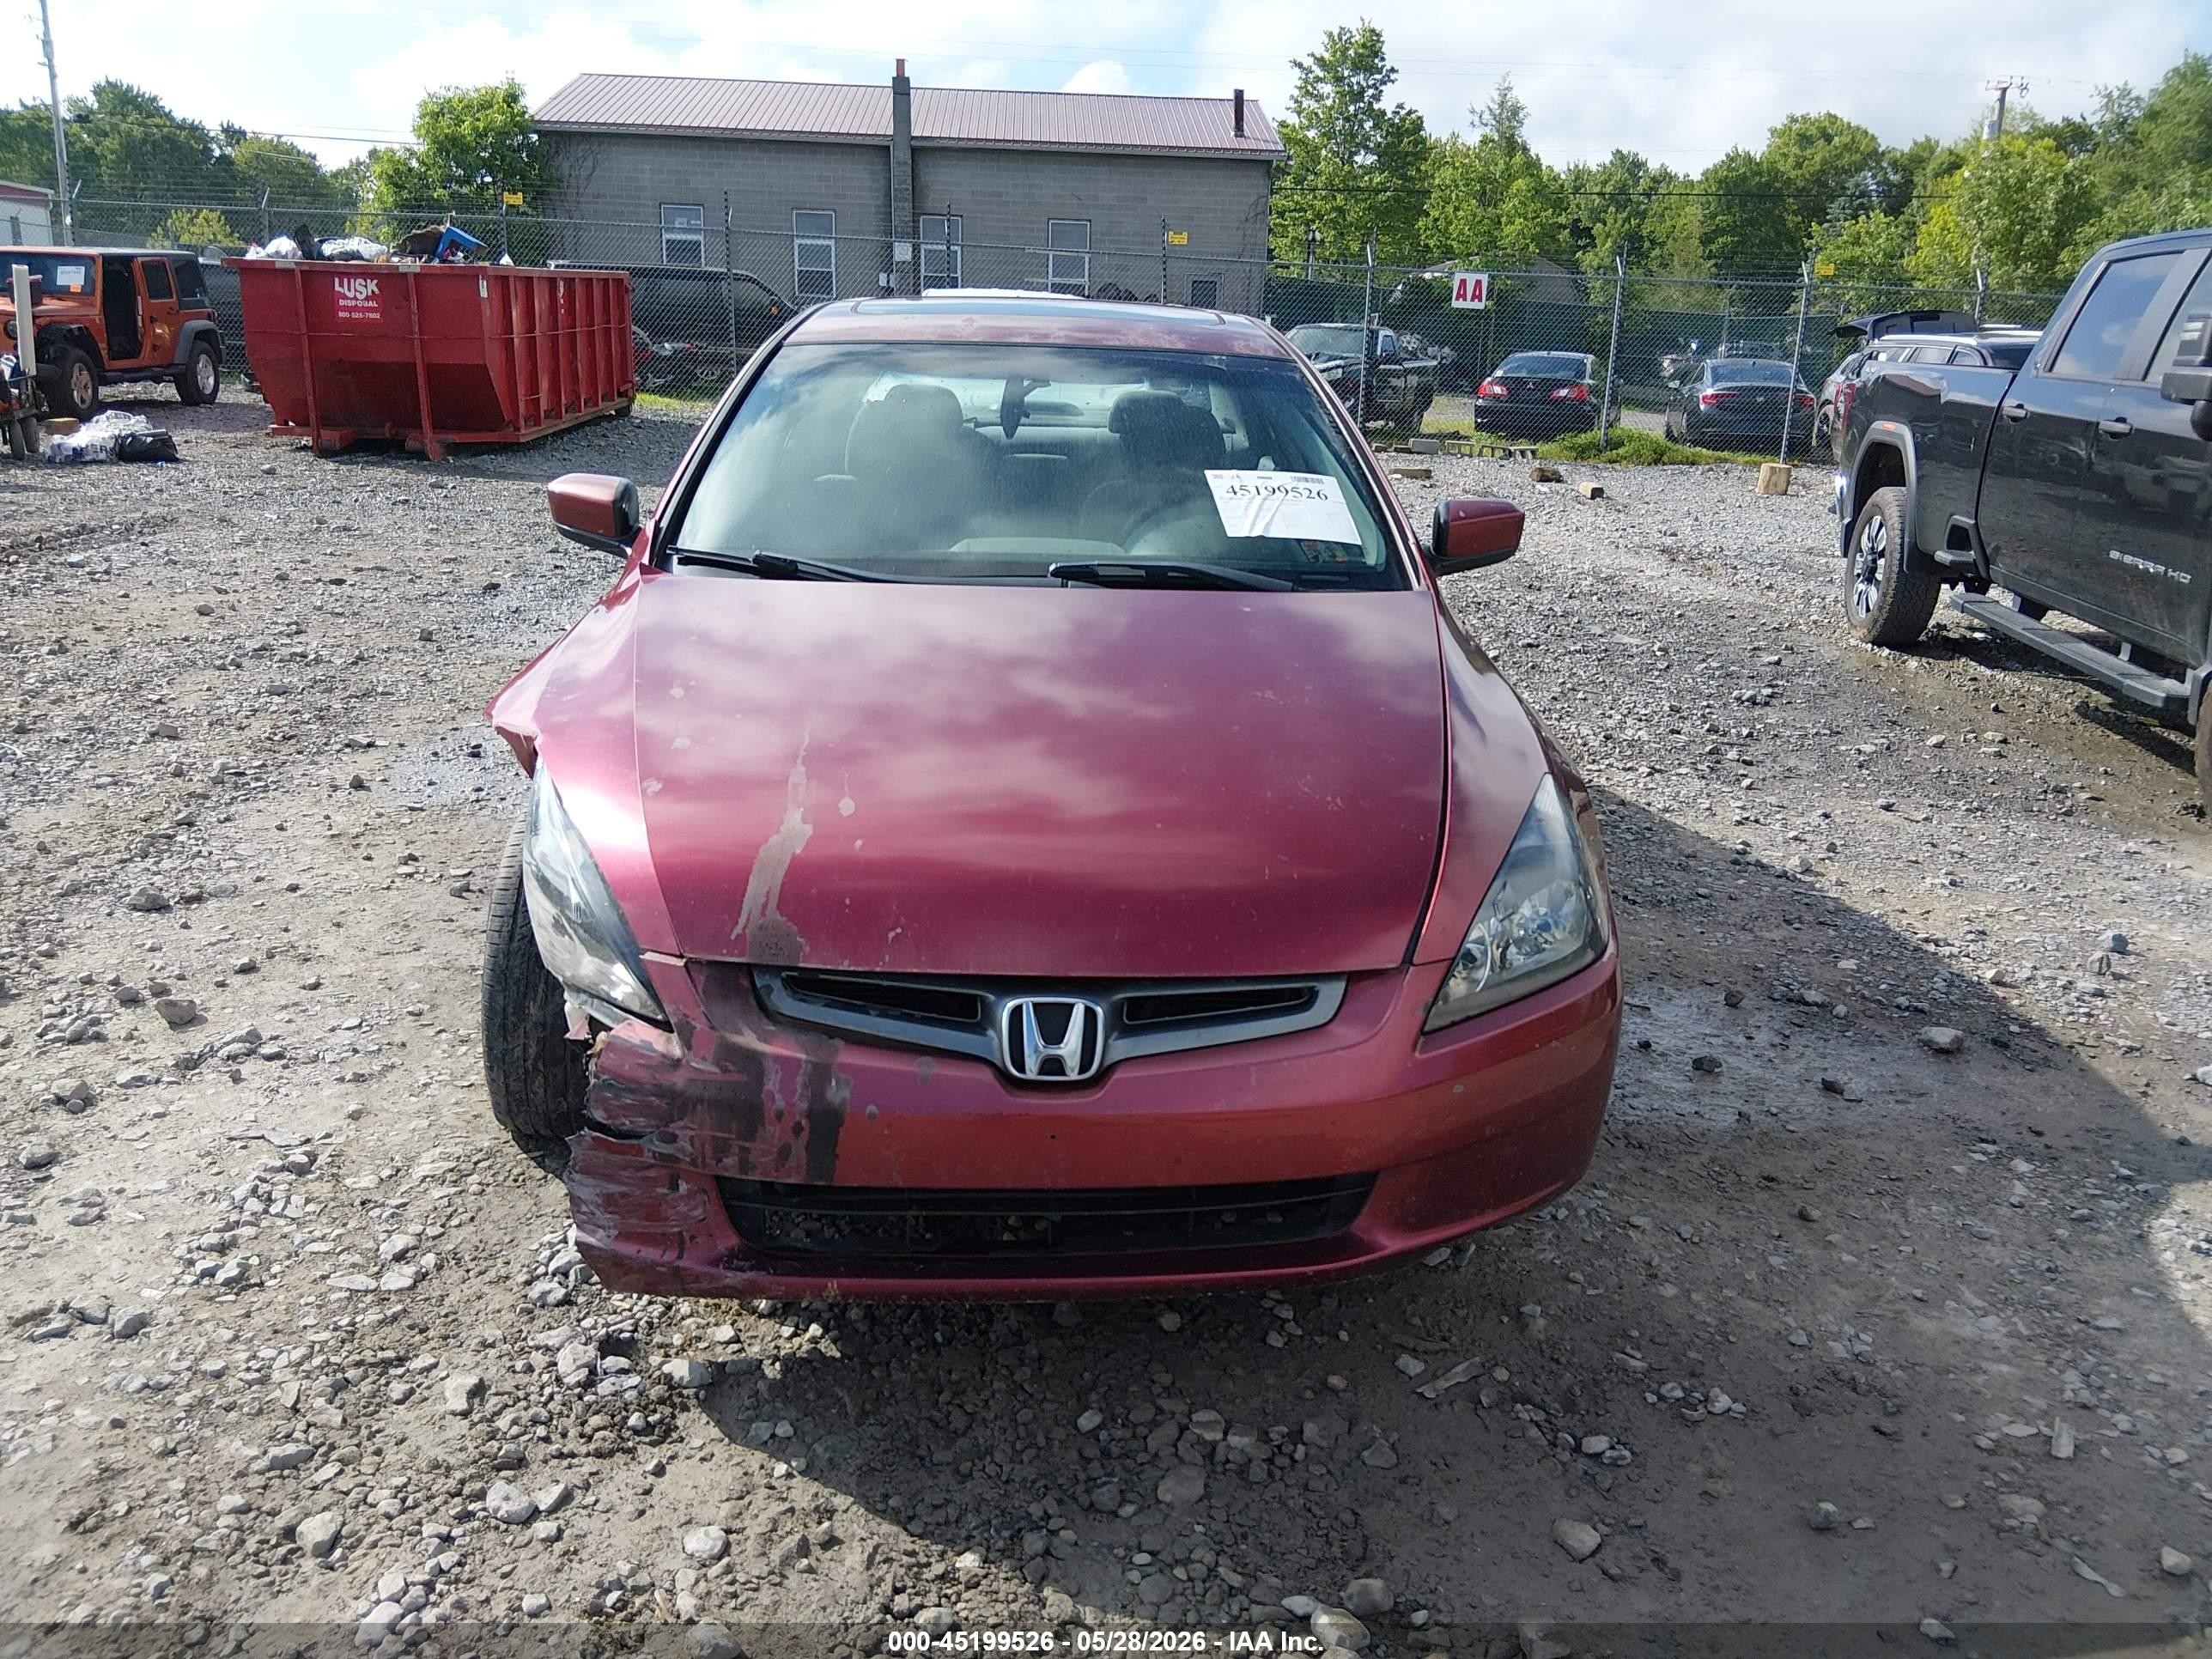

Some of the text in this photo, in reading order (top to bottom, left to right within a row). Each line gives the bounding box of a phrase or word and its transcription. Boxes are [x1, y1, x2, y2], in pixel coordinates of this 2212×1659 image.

[334, 276, 380, 300] LUSK
[1455, 278, 1483, 303] AA
[338, 299, 379, 307] DISPOSAL
[1226, 484, 1328, 501] 45199526
[2109, 550, 2192, 584] SIERRA HD
